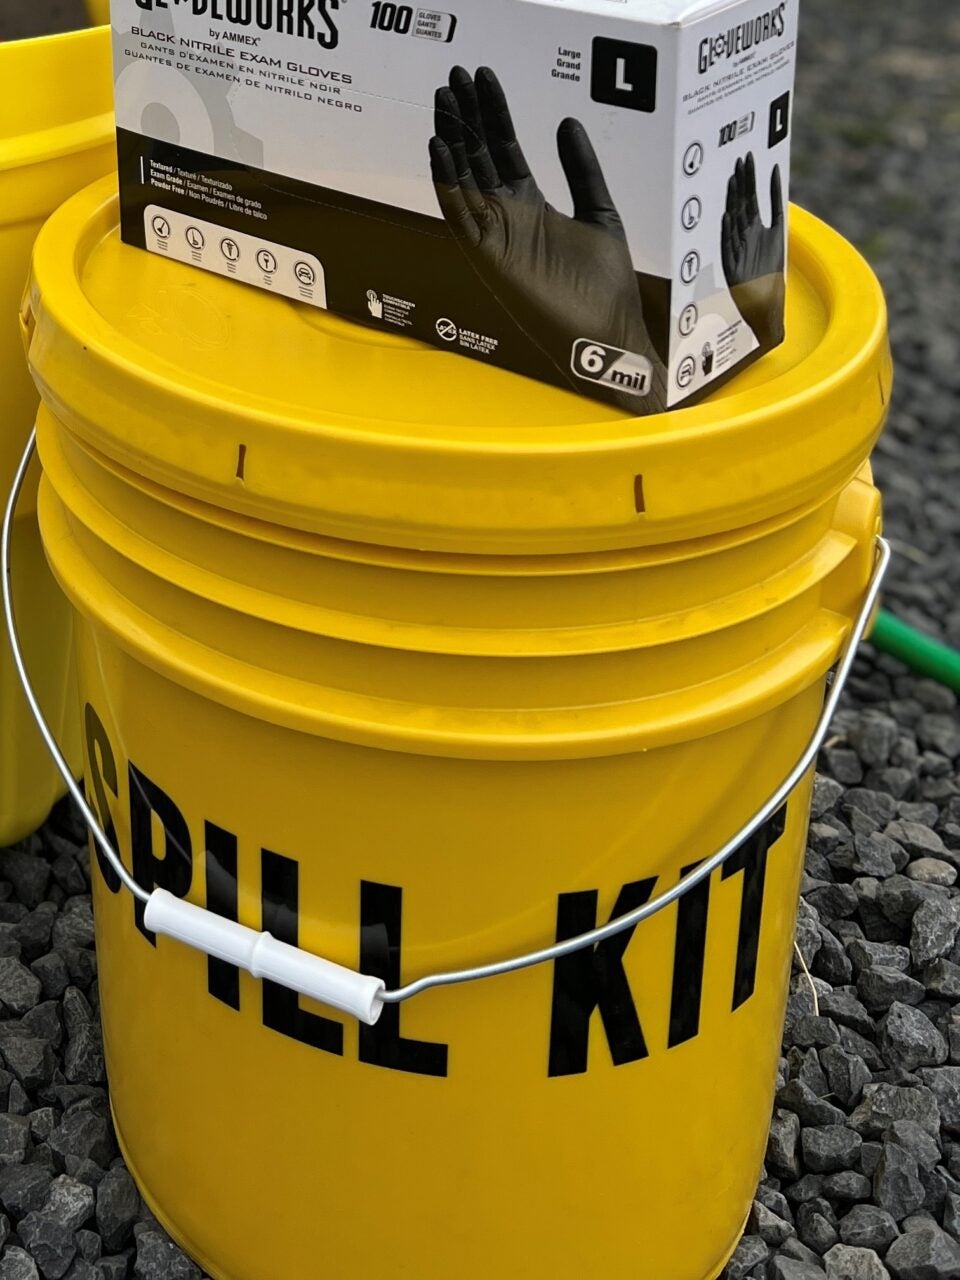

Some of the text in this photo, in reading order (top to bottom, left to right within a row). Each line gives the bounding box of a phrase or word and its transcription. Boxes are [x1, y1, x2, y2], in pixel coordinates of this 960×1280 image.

[370, 0, 413, 35] 100
[417, 20, 437, 29] GANTS
[418, 11, 441, 22] GLOVES
[209, 28, 220, 40] by
[416, 28, 442, 38] GUANTES
[131, 26, 352, 84] BLACK NITRILE EXAM GLOVES
[558, 46, 581, 59] Large
[141, 42, 341, 95] GANTS D'EXAMEN EN NITRILE NOIR
[556, 58, 581, 70] Grand
[616, 57, 633, 91] L
[124, 49, 362, 113] GUANTES DE EXAMEN DE NITRILO NEGRO
[551, 68, 581, 82] Grande
[775, 108, 783, 132] L
[150, 159, 173, 173] Textured
[150, 168, 165, 180] Exam
[166, 173, 183, 185] Grade
[186, 180, 209, 193] Examen
[213, 188, 235, 201] Examen
[236, 195, 244, 204] de
[244, 199, 262, 209] grado
[150, 177, 171, 191] Powder
[171, 184, 185, 195] Free
[188, 189, 201, 200] Non
[228, 201, 244, 213] Libre
[244, 207, 252, 216] de
[458, 328, 499, 346] LATEX FREE
[459, 334, 496, 351] SANS LATEX
[580, 345, 646, 390] 6 mil
[83, 702, 788, 1078] SPILL KIT
